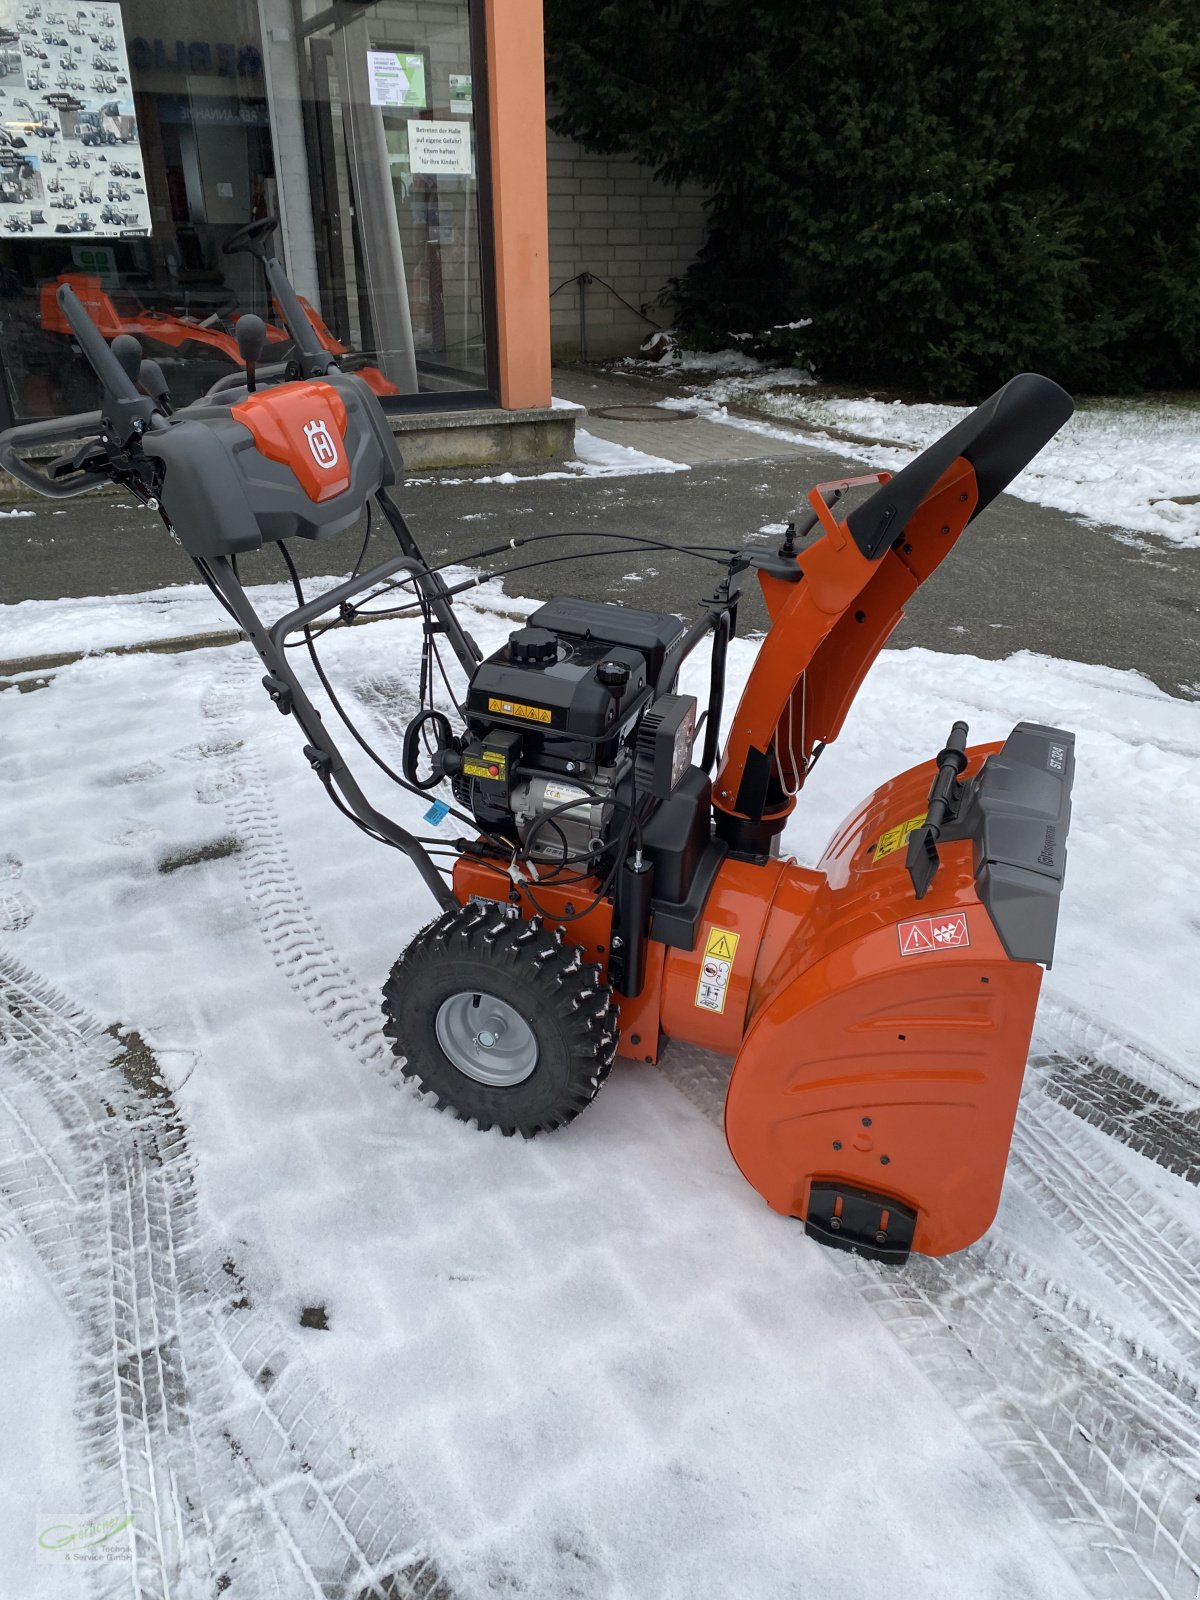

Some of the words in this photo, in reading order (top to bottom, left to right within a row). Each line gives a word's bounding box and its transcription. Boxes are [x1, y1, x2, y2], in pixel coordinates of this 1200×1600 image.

[416, 126, 438, 134] Betreten
[1051, 746, 1065, 762] 324
[1049, 760, 1063, 771] ST
